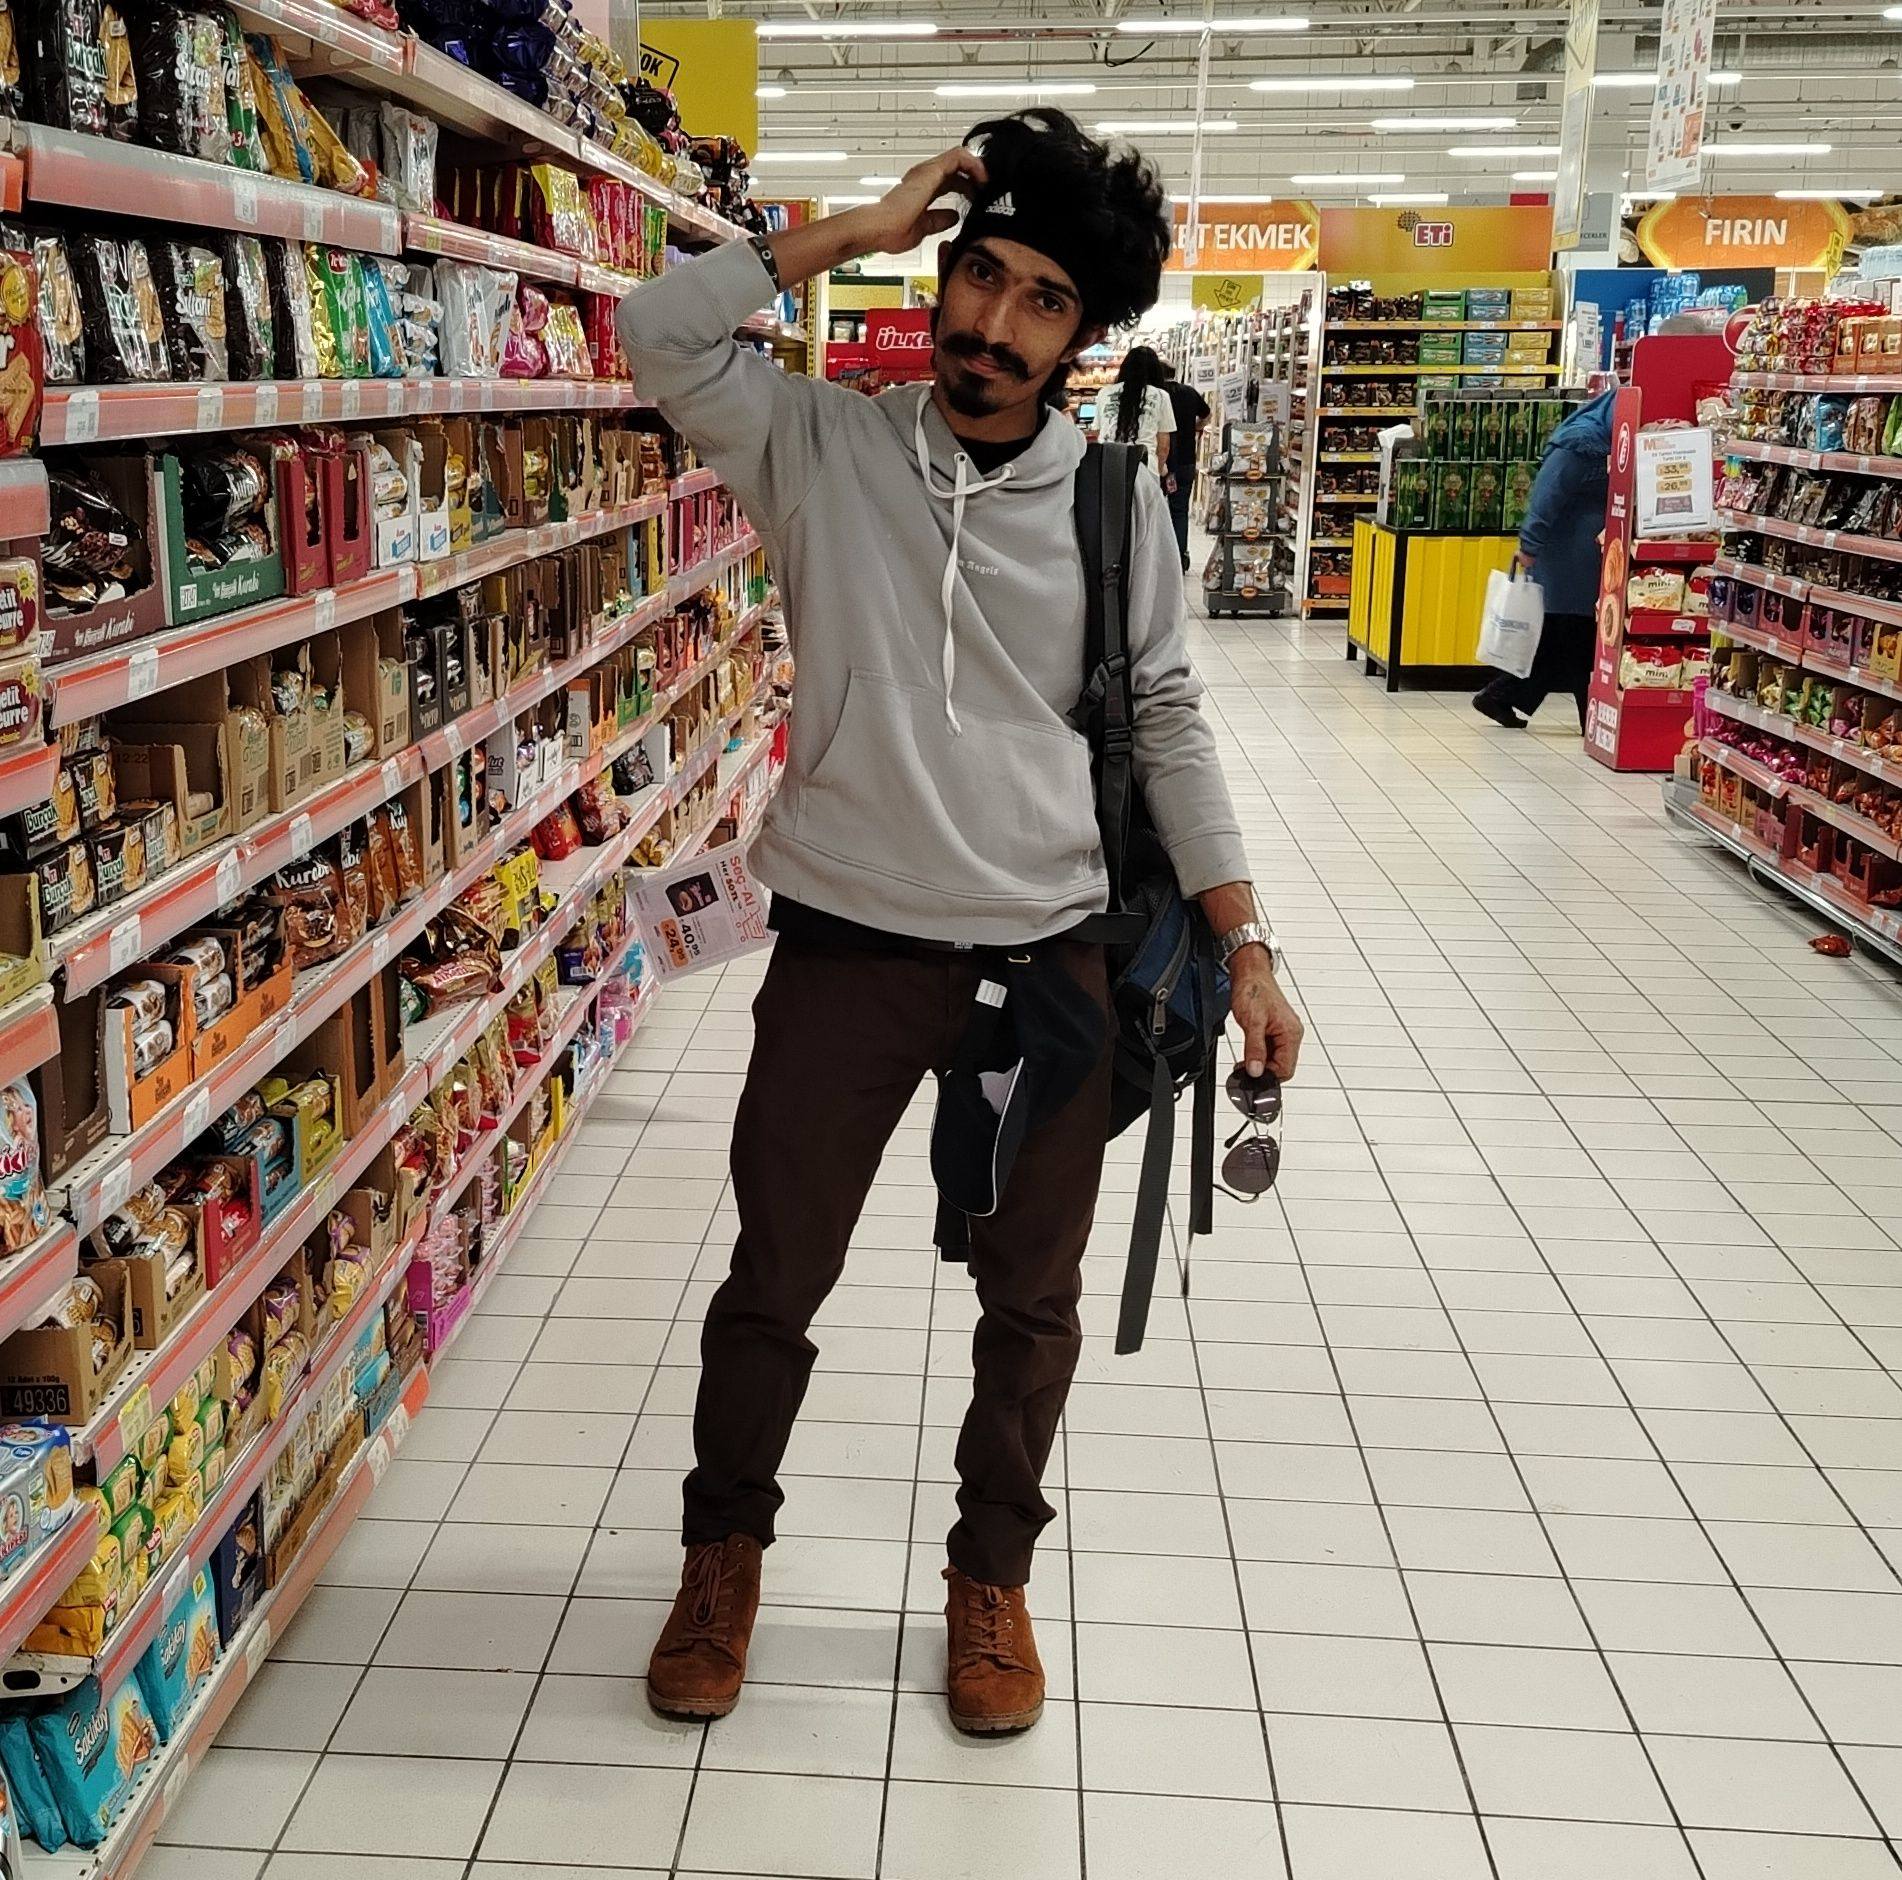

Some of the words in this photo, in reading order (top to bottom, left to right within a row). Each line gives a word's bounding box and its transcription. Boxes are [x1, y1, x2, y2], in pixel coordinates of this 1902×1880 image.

[641, 53, 664, 77] OK
[1215, 223, 1313, 250] EKMEK
[1705, 219, 1788, 245] FIRIN
[14, 1388, 67, 1412] 49336
